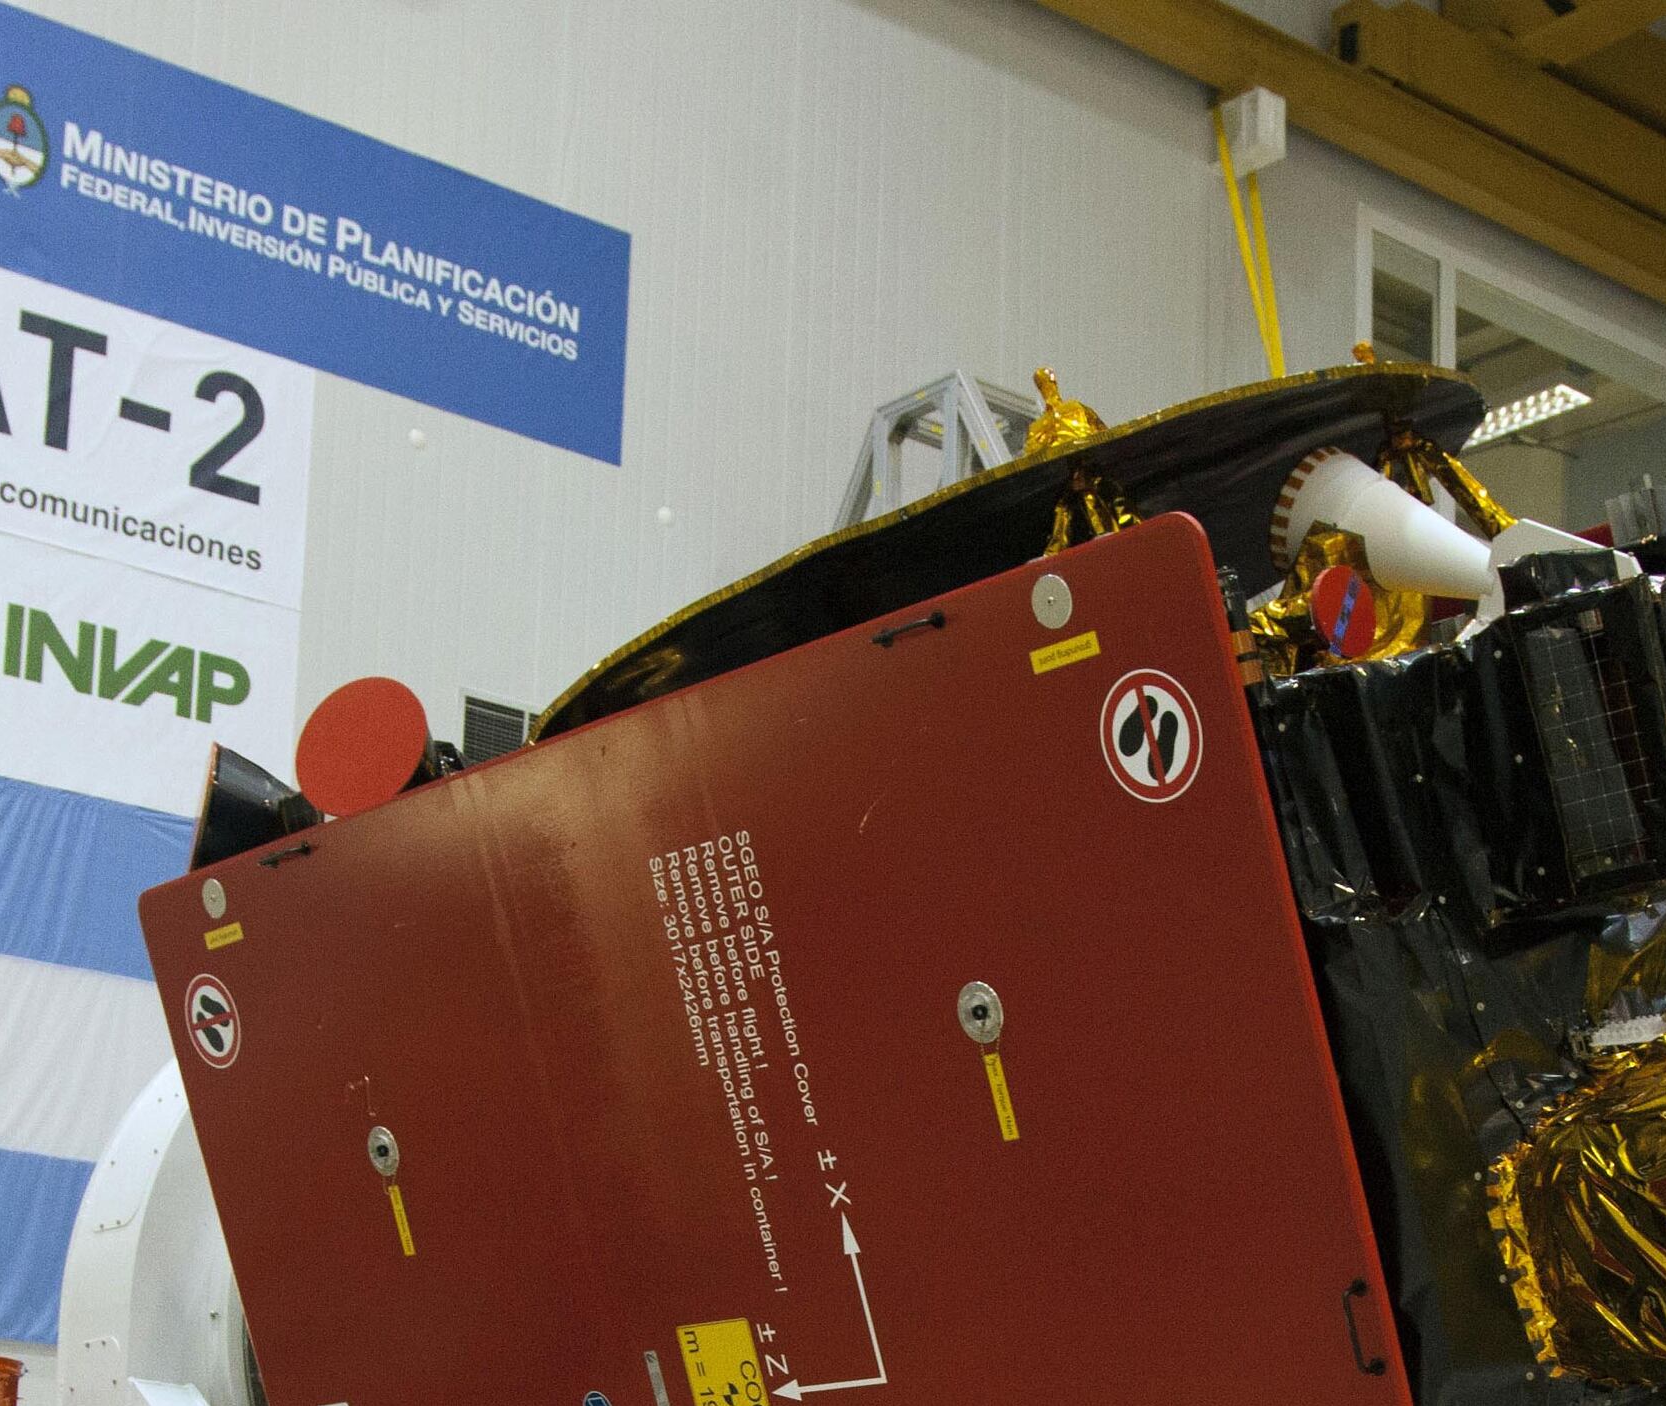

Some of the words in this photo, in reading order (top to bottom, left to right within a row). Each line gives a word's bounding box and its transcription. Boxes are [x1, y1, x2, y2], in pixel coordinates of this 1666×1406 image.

[60, 163, 185, 231] FEDERAL,
[188, 206, 321, 273] INVERSIÓN
[327, 253, 431, 311] PÚBLICA
[437, 294, 453, 317] Y
[457, 299, 578, 361] SERVICIOS
[64, 120, 273, 225] MINISTERIO
[282, 204, 327, 245] DE
[336, 216, 580, 333] PLANIFICACIÓN
[2, 603, 252, 724] INVAP
[683, 846, 712, 934] Remove
[718, 836, 749, 919] OUTER
[740, 925, 765, 979] SIDE
[649, 856, 670, 908] Size:
[663, 914, 709, 1066] 3017x2426mm
[700, 841, 729, 929] Remove
[723, 934, 748, 1001] before
[741, 1006, 764, 1058] flight
[706, 939, 731, 1006] before
[735, 830, 763, 899] SGEO
[754, 905, 774, 945] S/A
[765, 950, 800, 1056] Protection
[794, 1063, 818, 1126] Cover
[666, 851, 695, 938] Remove
[689, 944, 713, 1010] before
[706, 1015, 751, 1156] transportation
[743, 1162, 757, 1181] in
[750, 1186, 782, 1281] container
[724, 1011, 755, 1099] handling
[747, 1105, 765, 1126] of
[754, 1131, 774, 1169] S/A
[825, 1181, 852, 1208] X
[684, 1330, 700, 1354] m
[696, 1361, 706, 1377] =
[764, 1354, 789, 1377] Z
